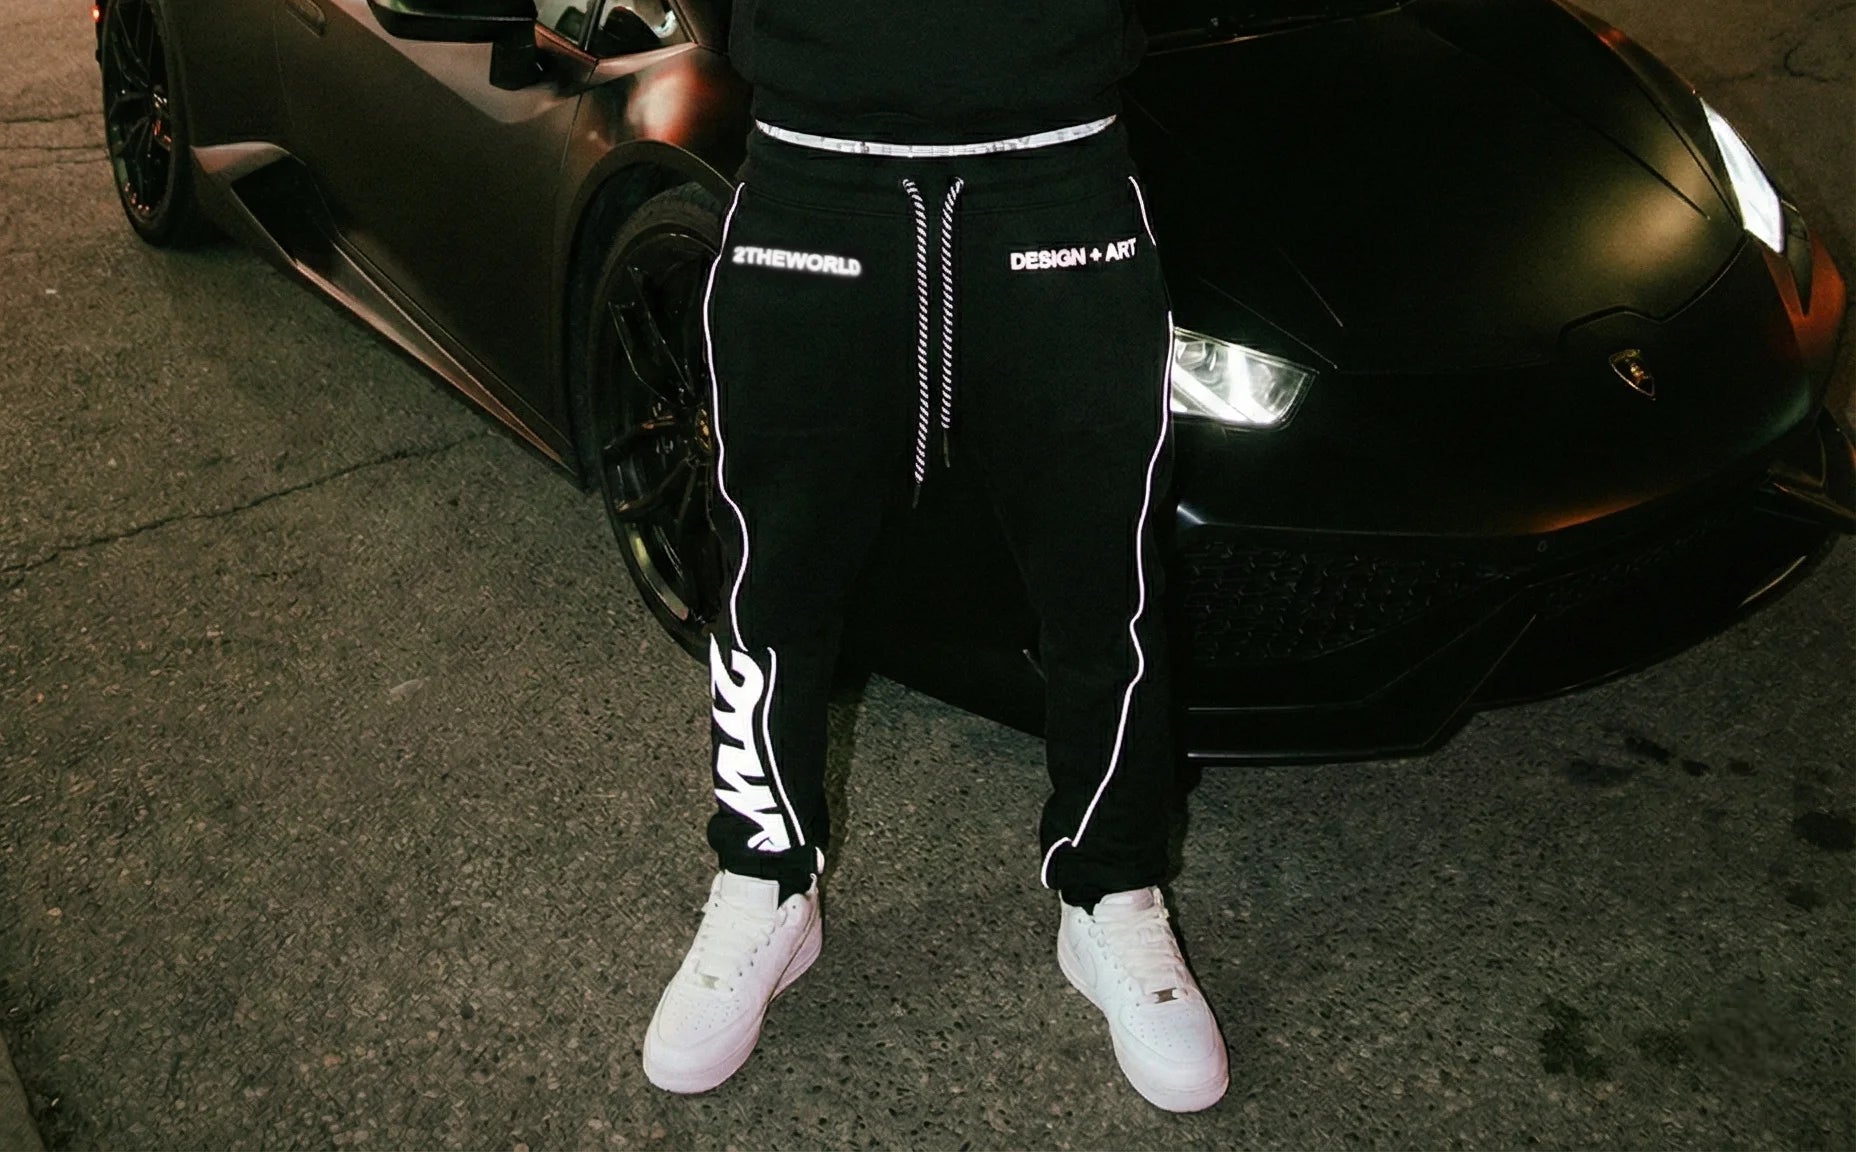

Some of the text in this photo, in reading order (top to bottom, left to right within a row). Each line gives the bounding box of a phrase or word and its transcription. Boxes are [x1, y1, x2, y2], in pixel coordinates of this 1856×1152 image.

[732, 246, 862, 277] 2THEWORLD
[1010, 237, 1137, 270] DESIGN + ART
